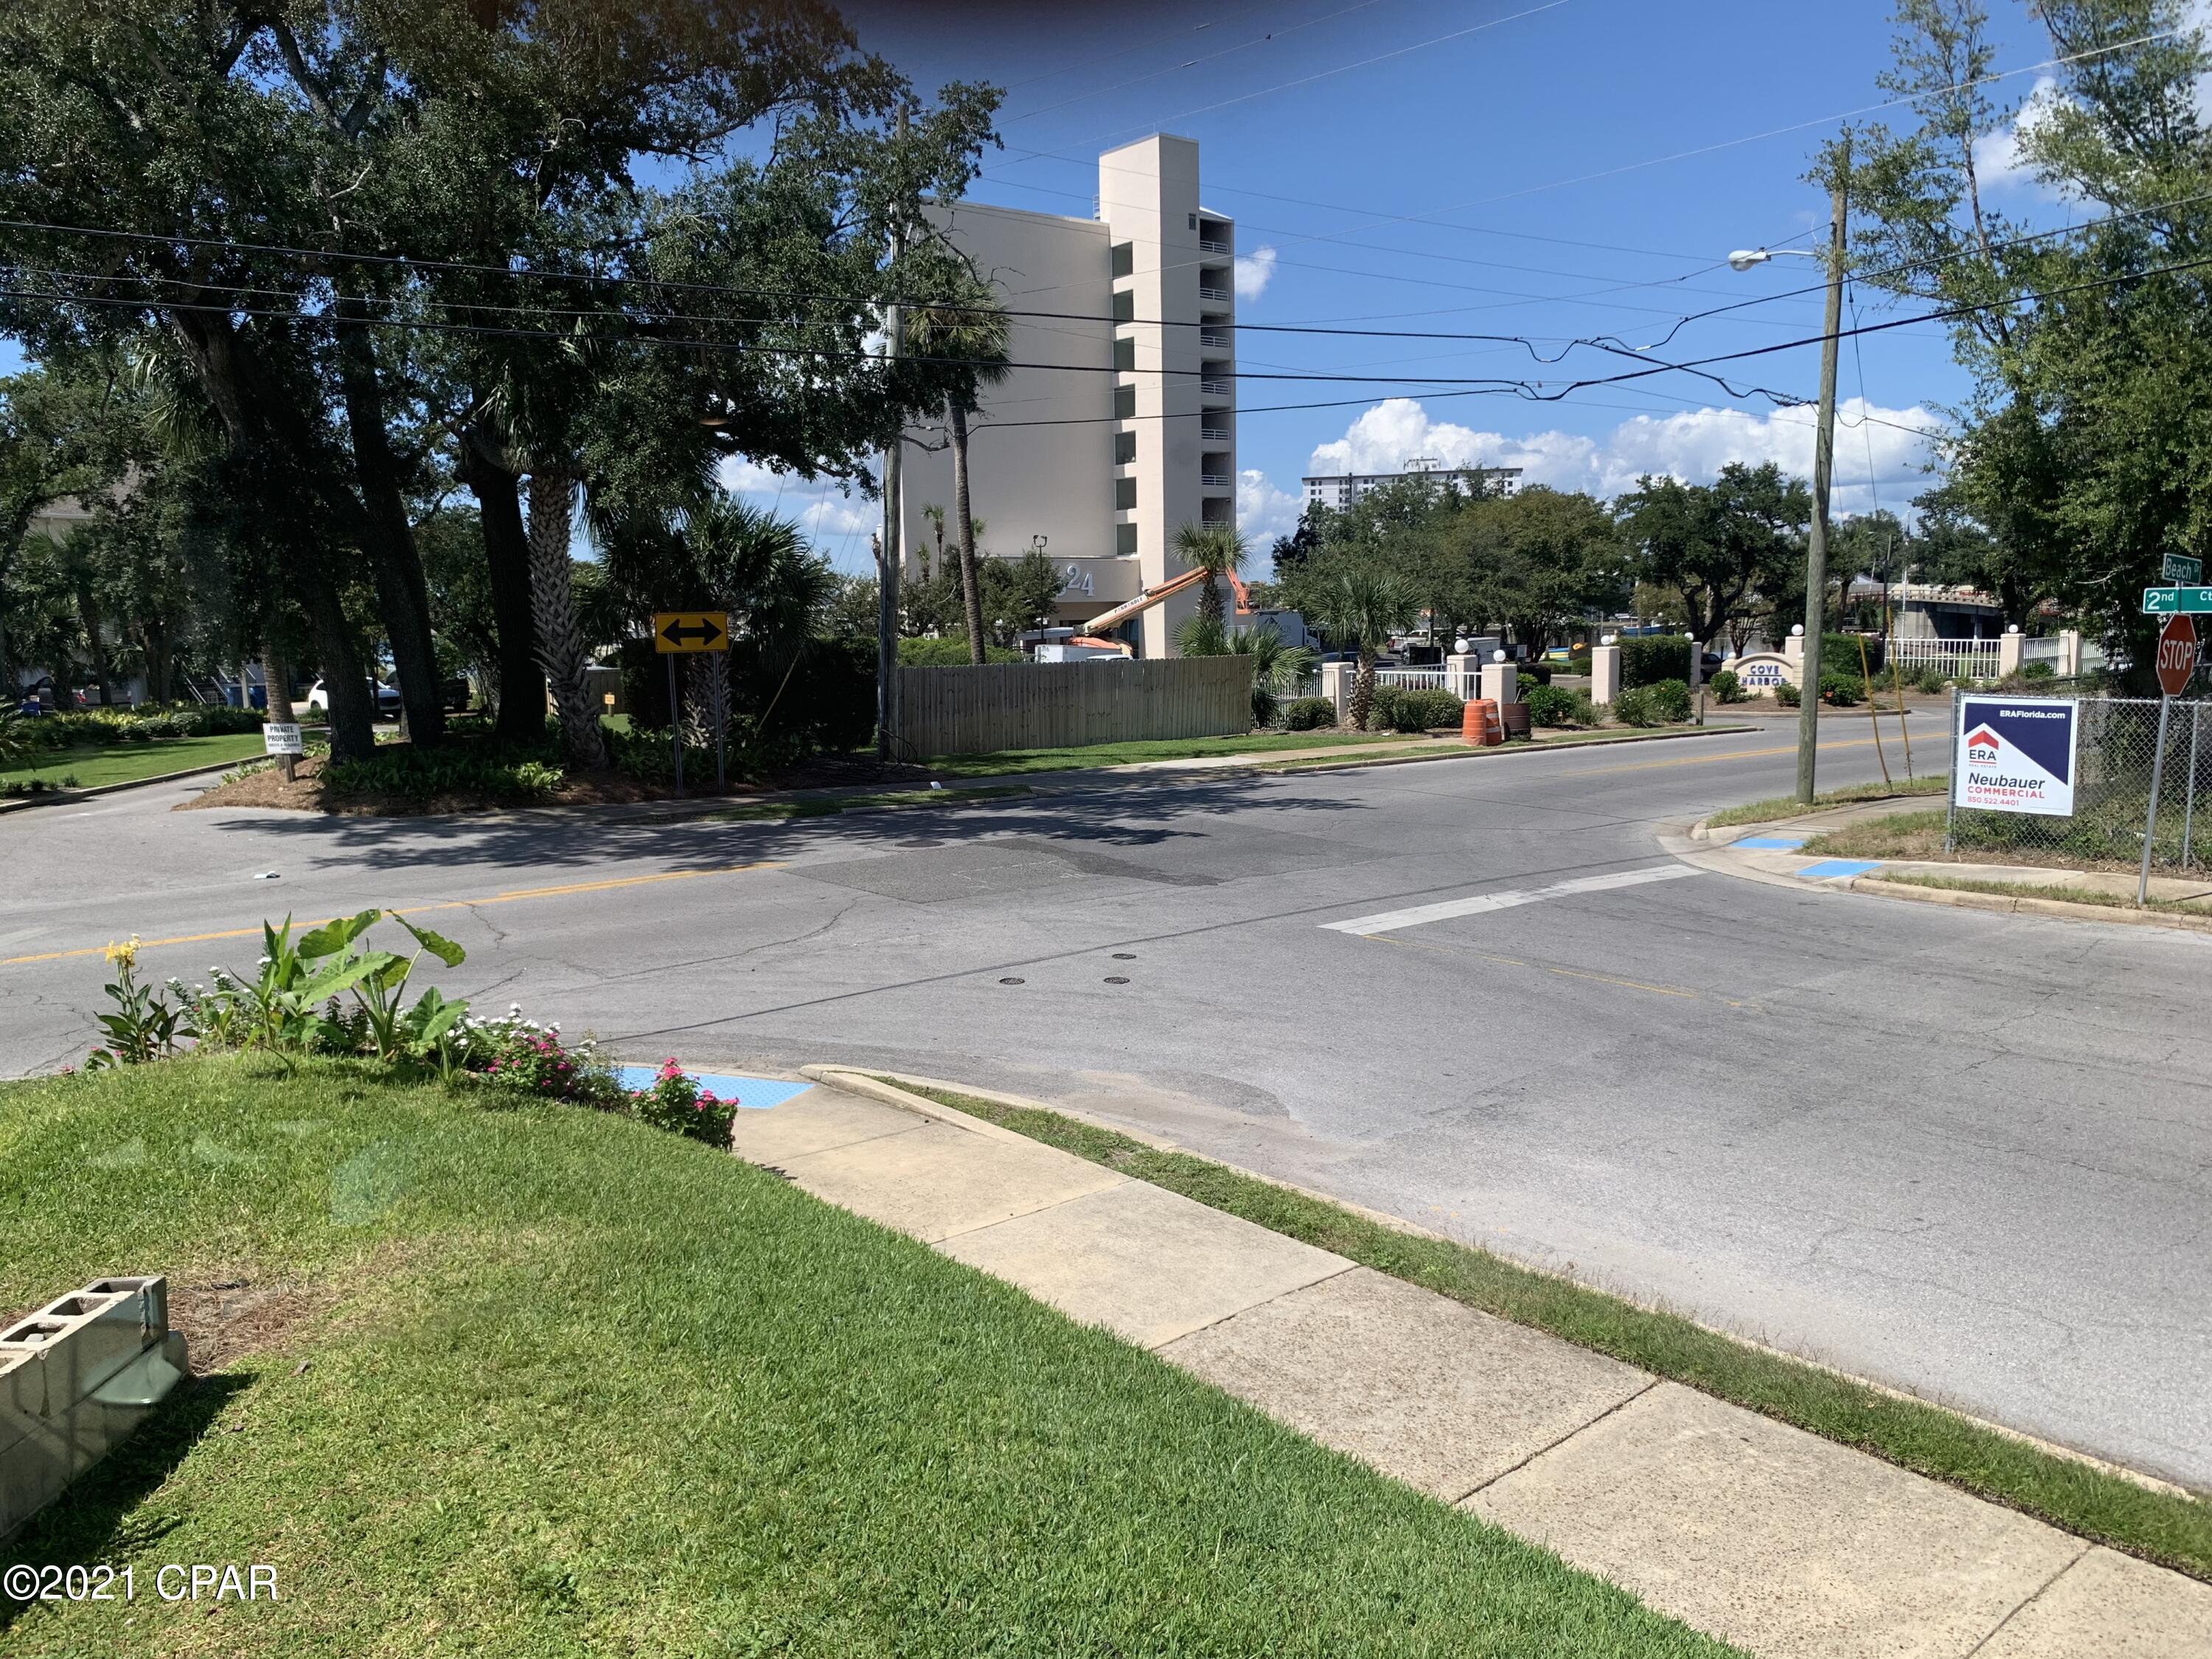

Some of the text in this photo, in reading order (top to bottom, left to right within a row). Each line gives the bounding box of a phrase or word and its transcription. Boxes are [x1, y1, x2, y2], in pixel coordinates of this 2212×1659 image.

[2165, 558, 2200, 580] Beach Dr
[2146, 592, 2174, 610] 2nd
[2160, 639, 2193, 670] STOP
[1750, 666, 1779, 674] COVE
[2000, 710, 2066, 719] ERAFlorida.com
[1969, 749, 1997, 761] ERA
[1968, 773, 2045, 789] Neubauer
[1967, 786, 2045, 799] COMMERCIAL
[1967, 796, 2020, 806] 850.522.4401
